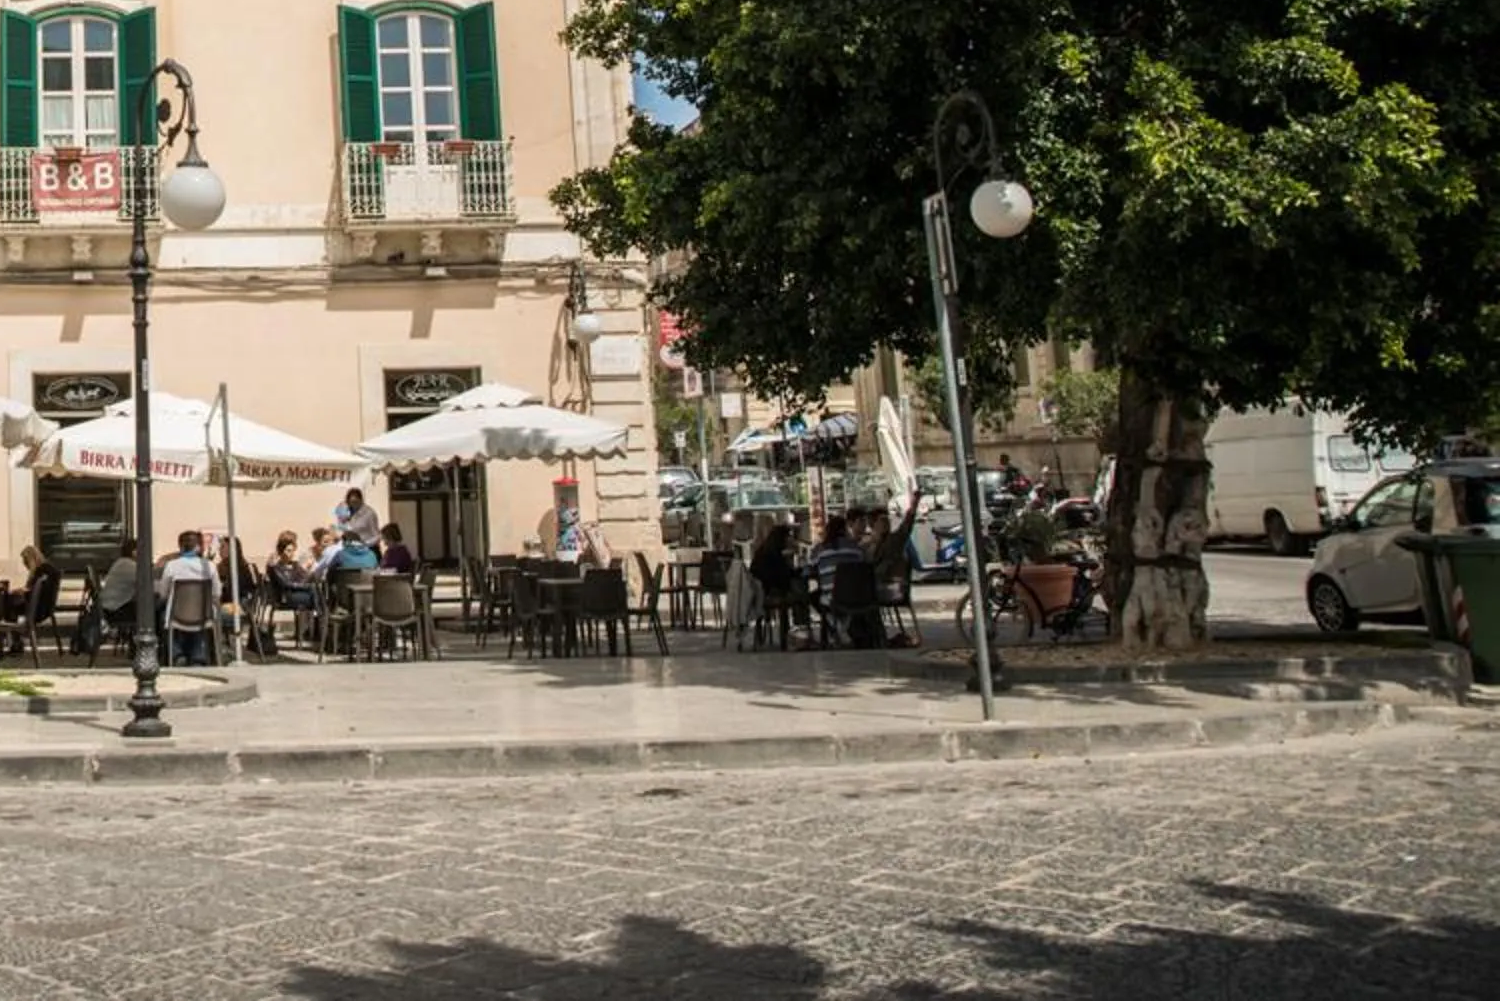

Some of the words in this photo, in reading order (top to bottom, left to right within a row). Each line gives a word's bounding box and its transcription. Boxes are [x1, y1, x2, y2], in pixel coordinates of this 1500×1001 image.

[40, 162, 60, 192] B
[67, 162, 89, 192] &
[94, 162, 115, 190] B
[80, 449, 126, 470] BIRRA
[240, 461, 282, 478] BIRRA
[287, 465, 352, 482] MORETTI
